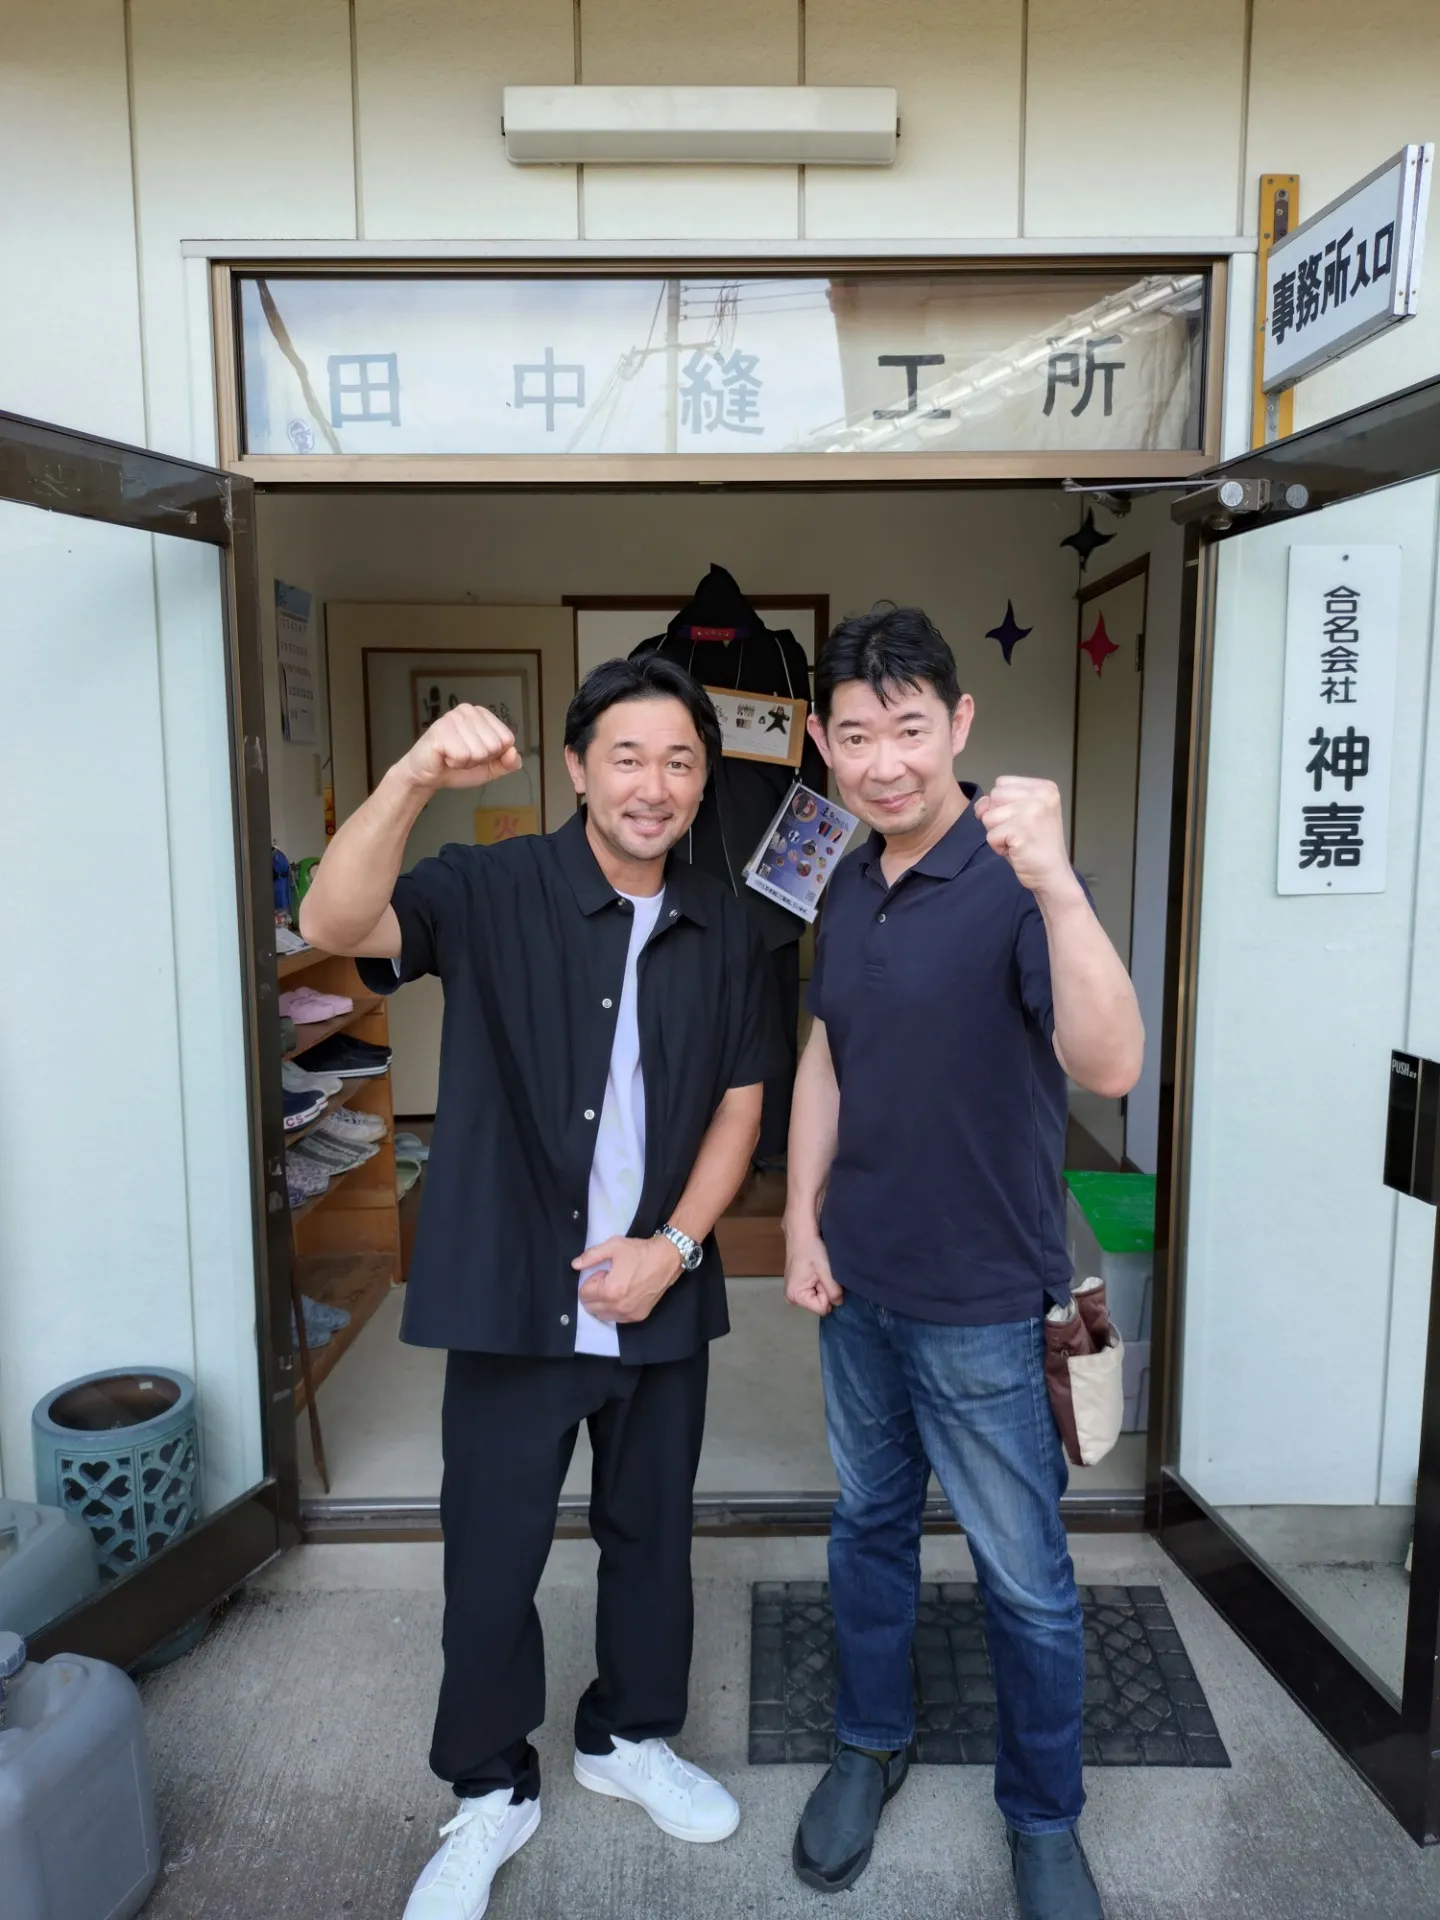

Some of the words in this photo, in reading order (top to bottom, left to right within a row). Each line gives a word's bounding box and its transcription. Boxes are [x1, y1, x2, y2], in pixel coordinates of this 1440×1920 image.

[1271, 220, 1395, 345] 事務所入口
[328, 335, 1126, 436] 田中縫工所
[1319, 585, 1361, 705] 合名会社
[1298, 725, 1370, 869] 神嘉
[1392, 1059, 1410, 1077] PUSH
